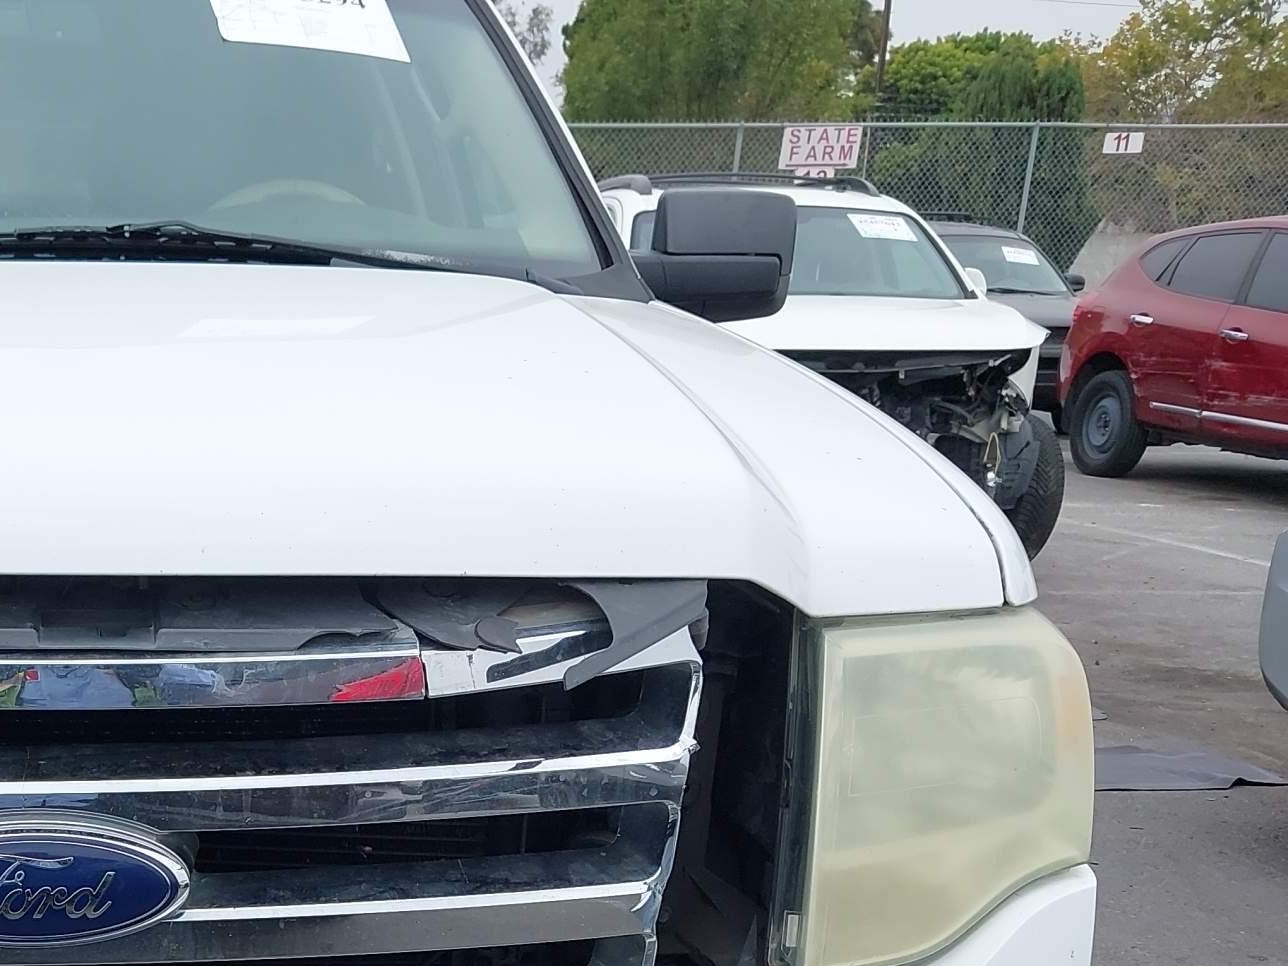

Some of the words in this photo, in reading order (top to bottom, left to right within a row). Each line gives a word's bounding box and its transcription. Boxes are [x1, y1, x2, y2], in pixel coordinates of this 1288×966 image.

[789, 128, 859, 144] STATE
[1113, 133, 1130, 152] 11
[789, 145, 854, 161] FARM
